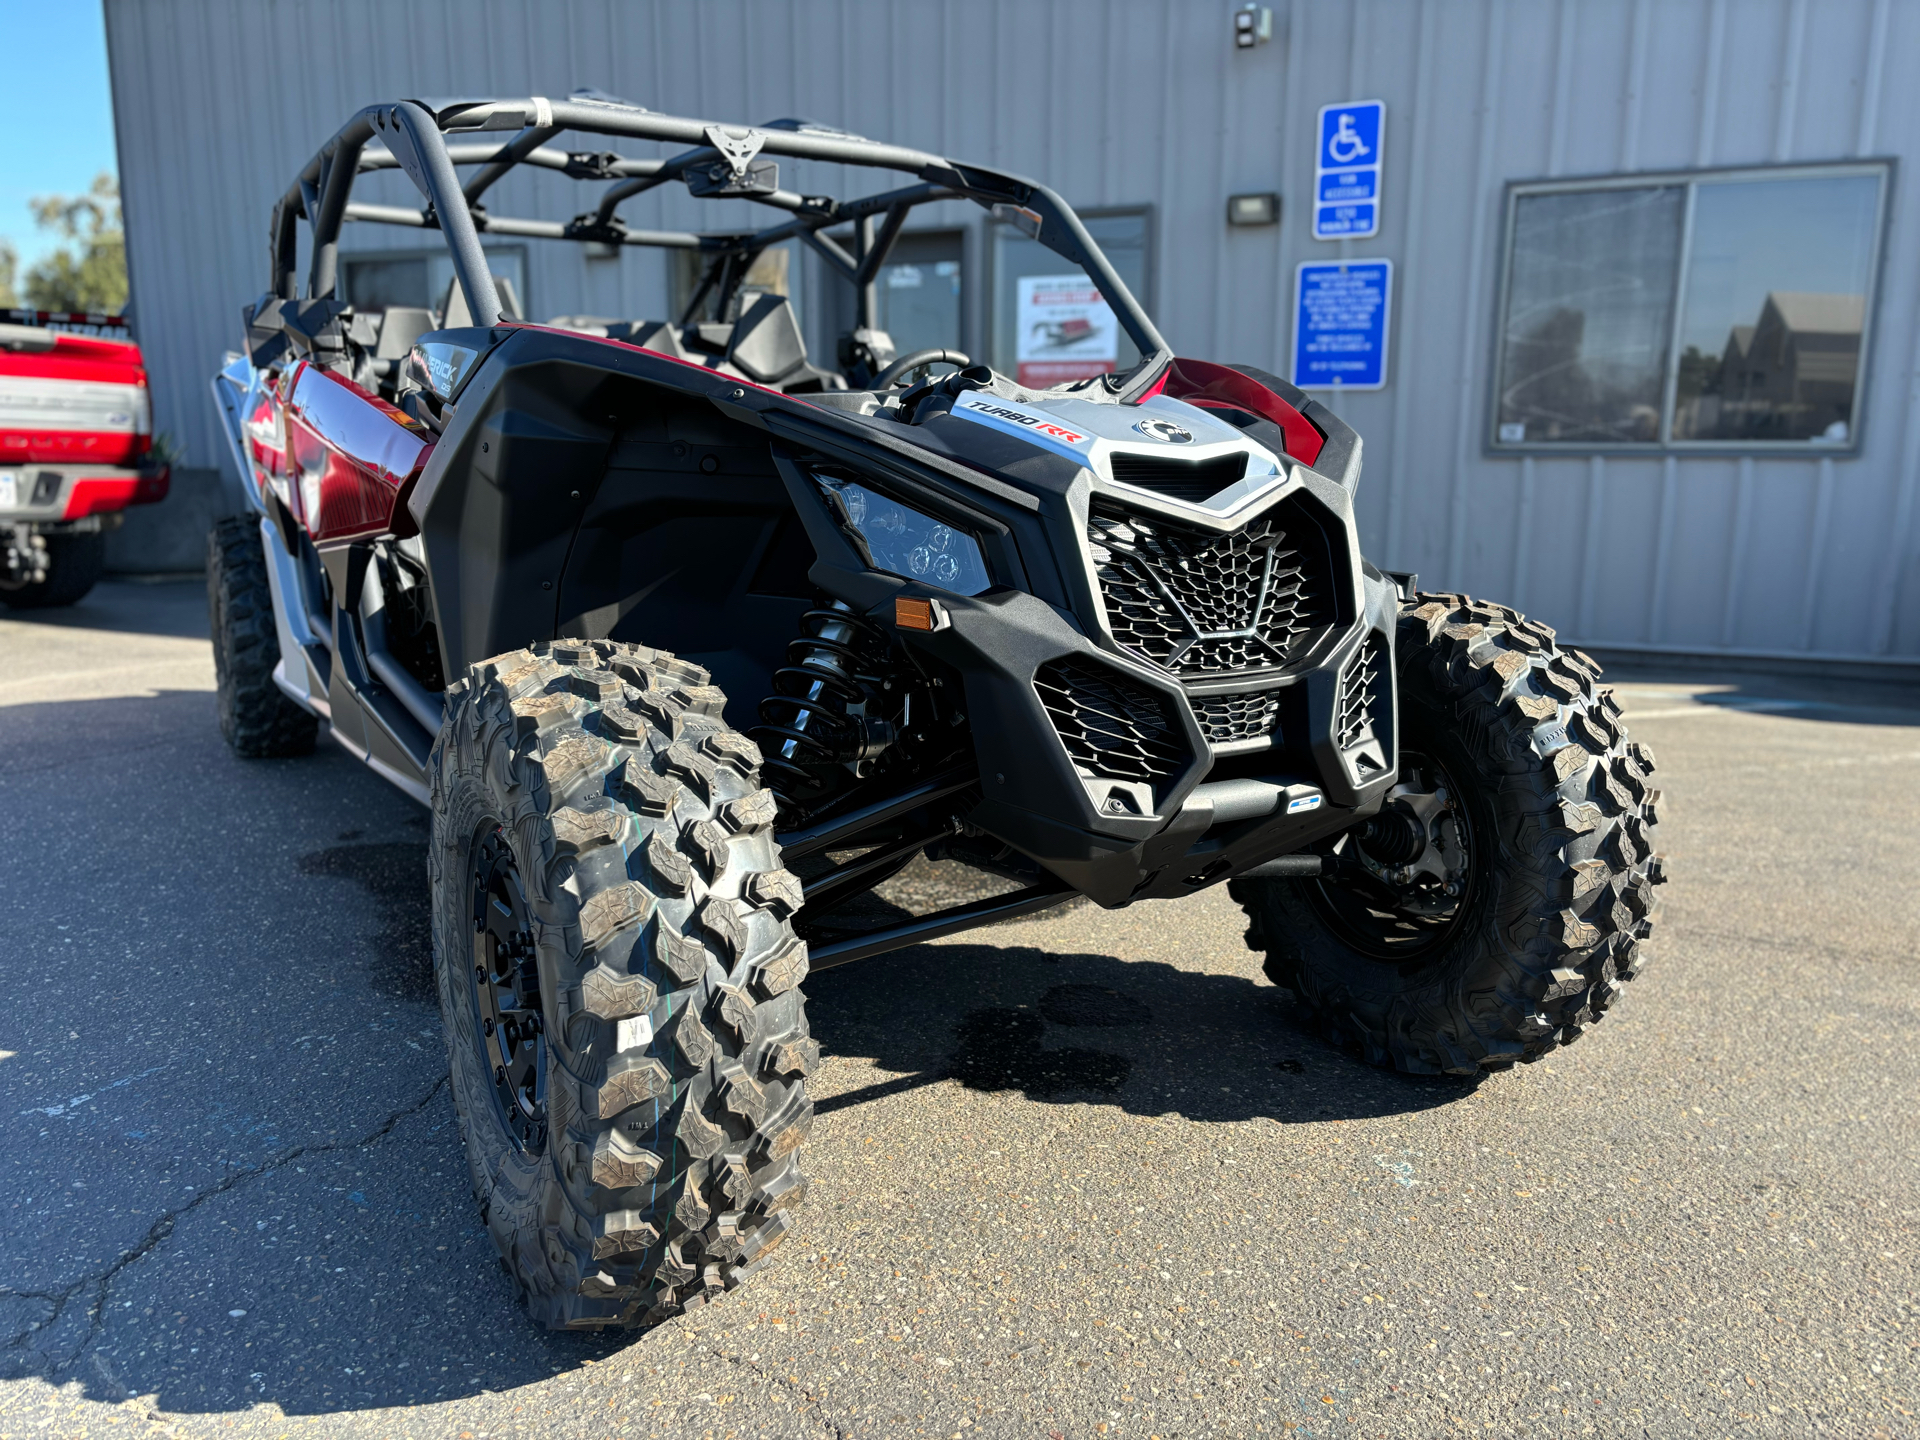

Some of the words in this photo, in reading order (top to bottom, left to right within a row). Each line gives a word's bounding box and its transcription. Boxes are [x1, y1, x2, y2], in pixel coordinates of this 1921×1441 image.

[414, 348, 457, 382] MAVERICK
[969, 401, 1041, 425] TURBO
[1035, 423, 1083, 443] RR
[4, 435, 98, 449] DUTY
